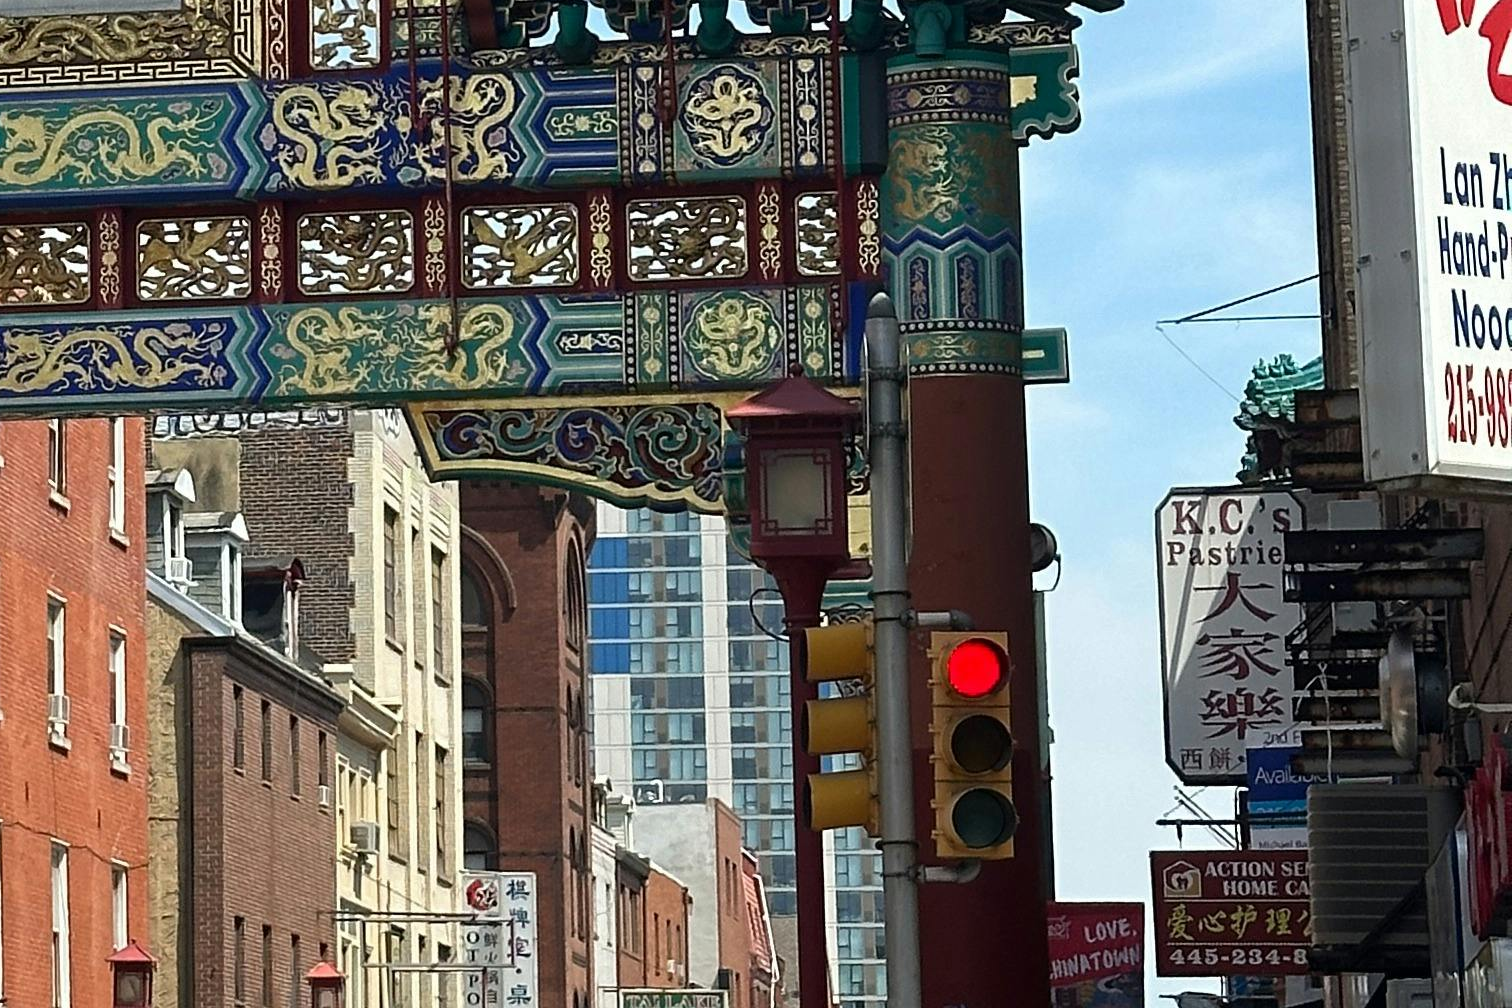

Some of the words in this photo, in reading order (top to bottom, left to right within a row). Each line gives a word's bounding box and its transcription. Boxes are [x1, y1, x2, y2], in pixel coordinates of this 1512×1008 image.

[1439, 146, 1484, 208] Lan
[1437, 215, 1512, 279] Hand-P
[1445, 361, 1512, 449] 215-98
[1171, 498, 1292, 535] K.C.'s
[1166, 540, 1283, 567] Pastrie
[1193, 572, 1285, 741] 大家樂
[1204, 861, 1276, 877] ACTION
[1223, 880, 1278, 896] HOME
[1049, 943, 1140, 980] HINATOWN
